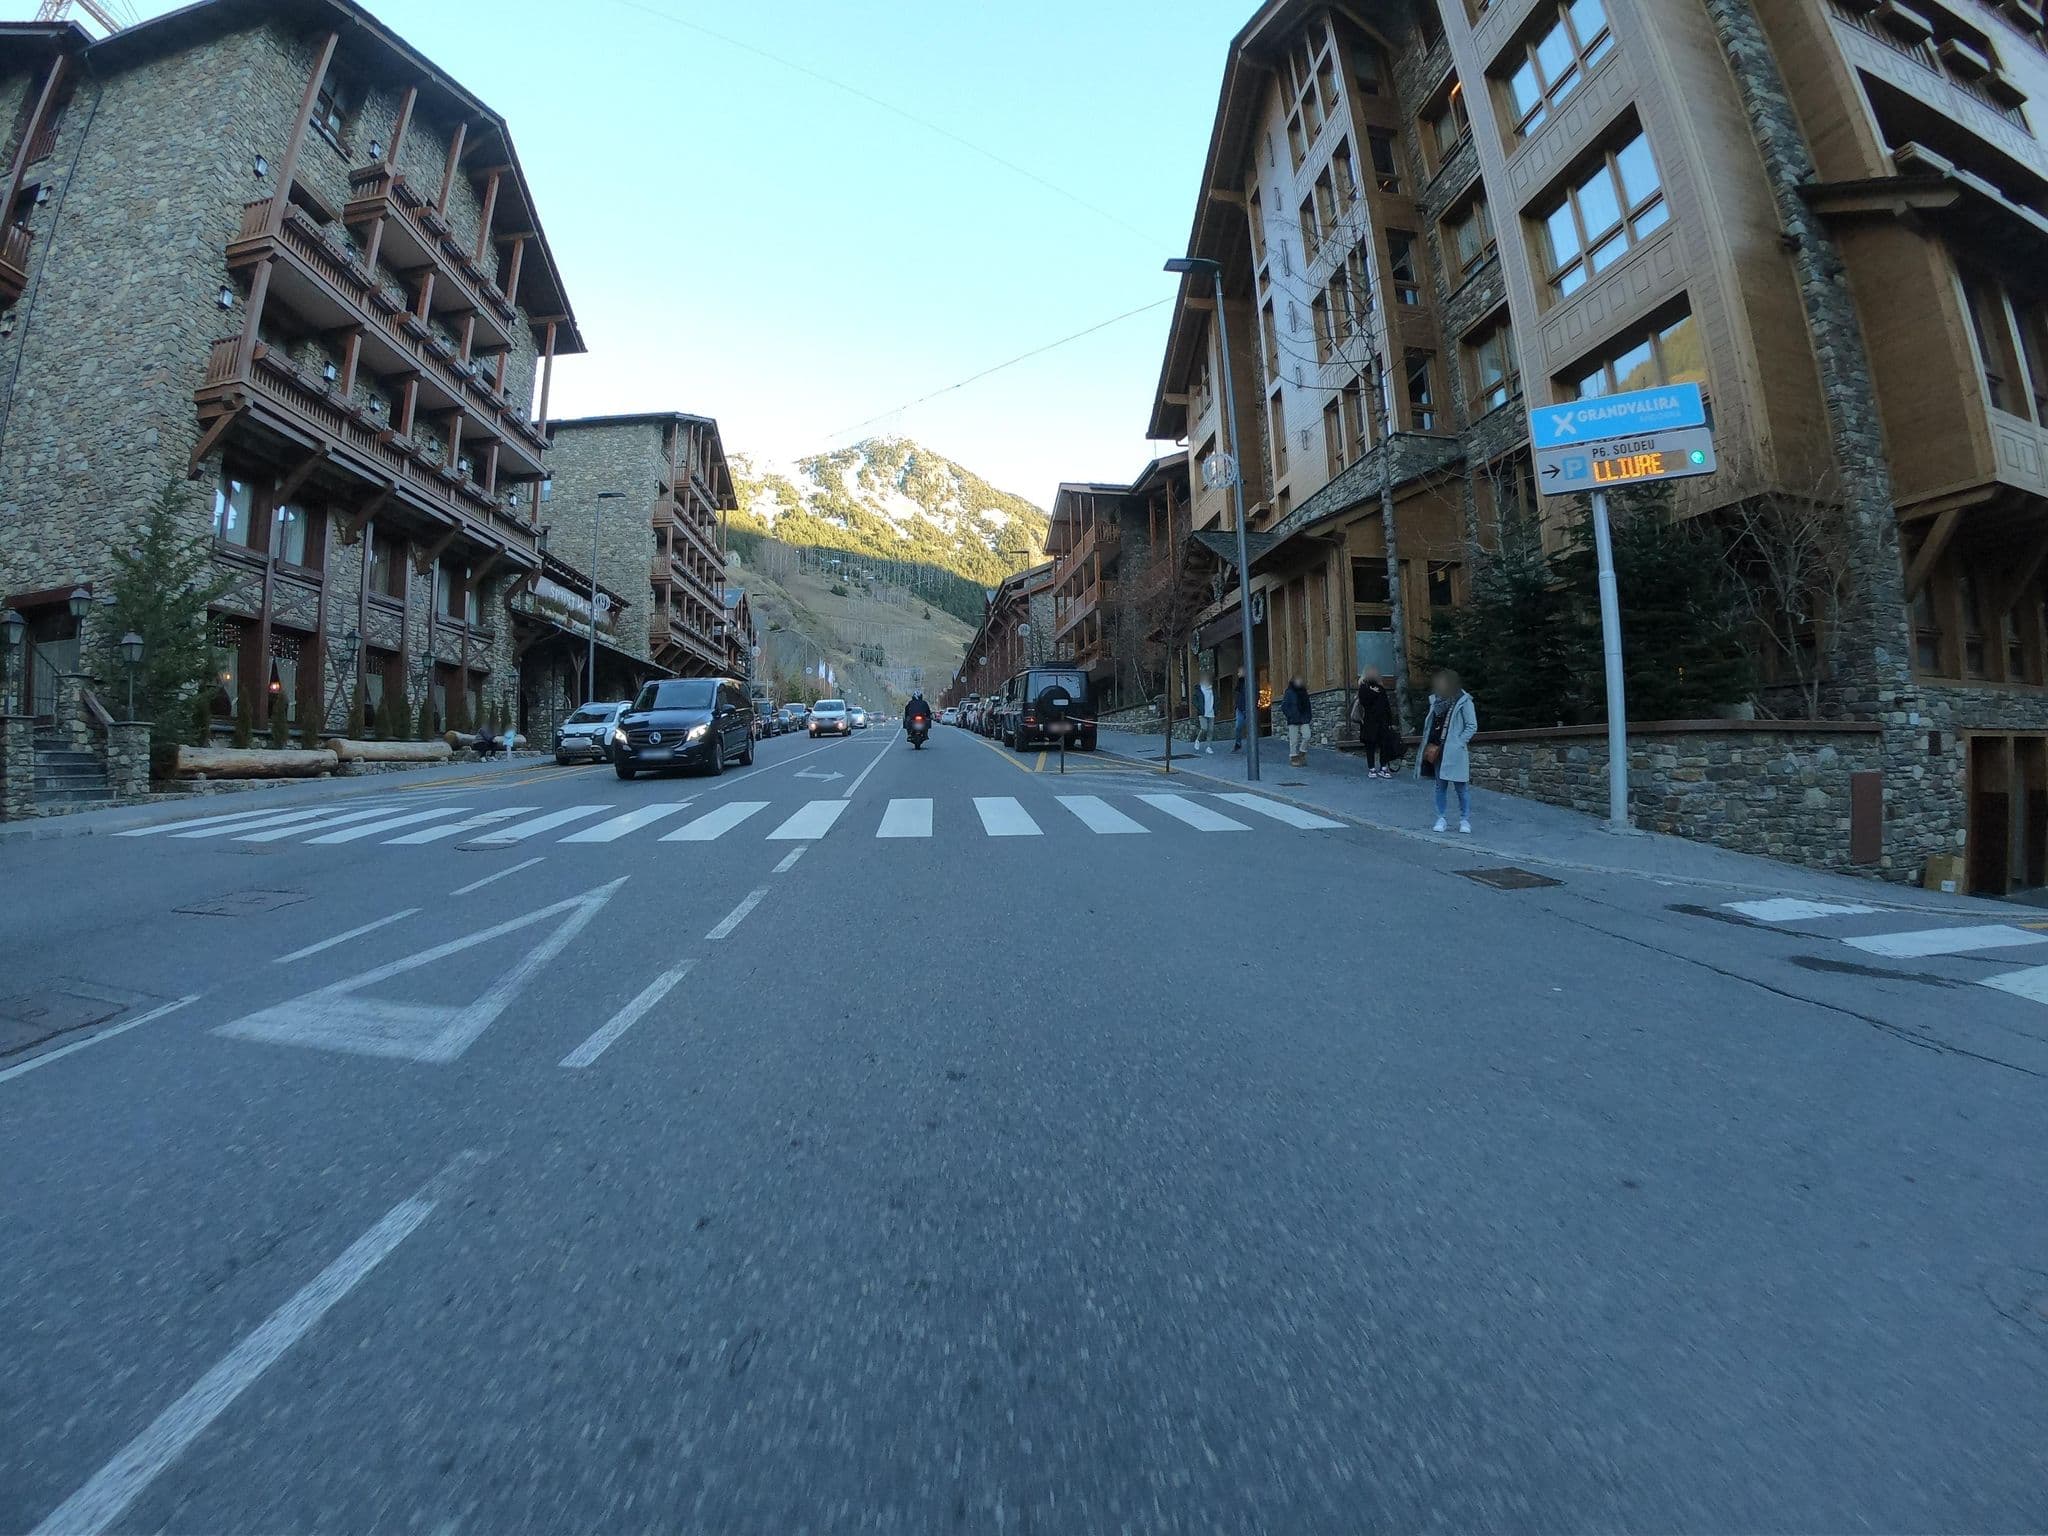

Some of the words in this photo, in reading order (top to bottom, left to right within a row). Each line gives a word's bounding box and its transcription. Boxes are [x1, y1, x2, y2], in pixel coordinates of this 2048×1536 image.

[1577, 396, 1680, 423] GRANDVALIRA
[1592, 447, 1609, 459] P6.
[1613, 440, 1655, 455] SOLDEU
[1593, 453, 1665, 482] LLIURE
